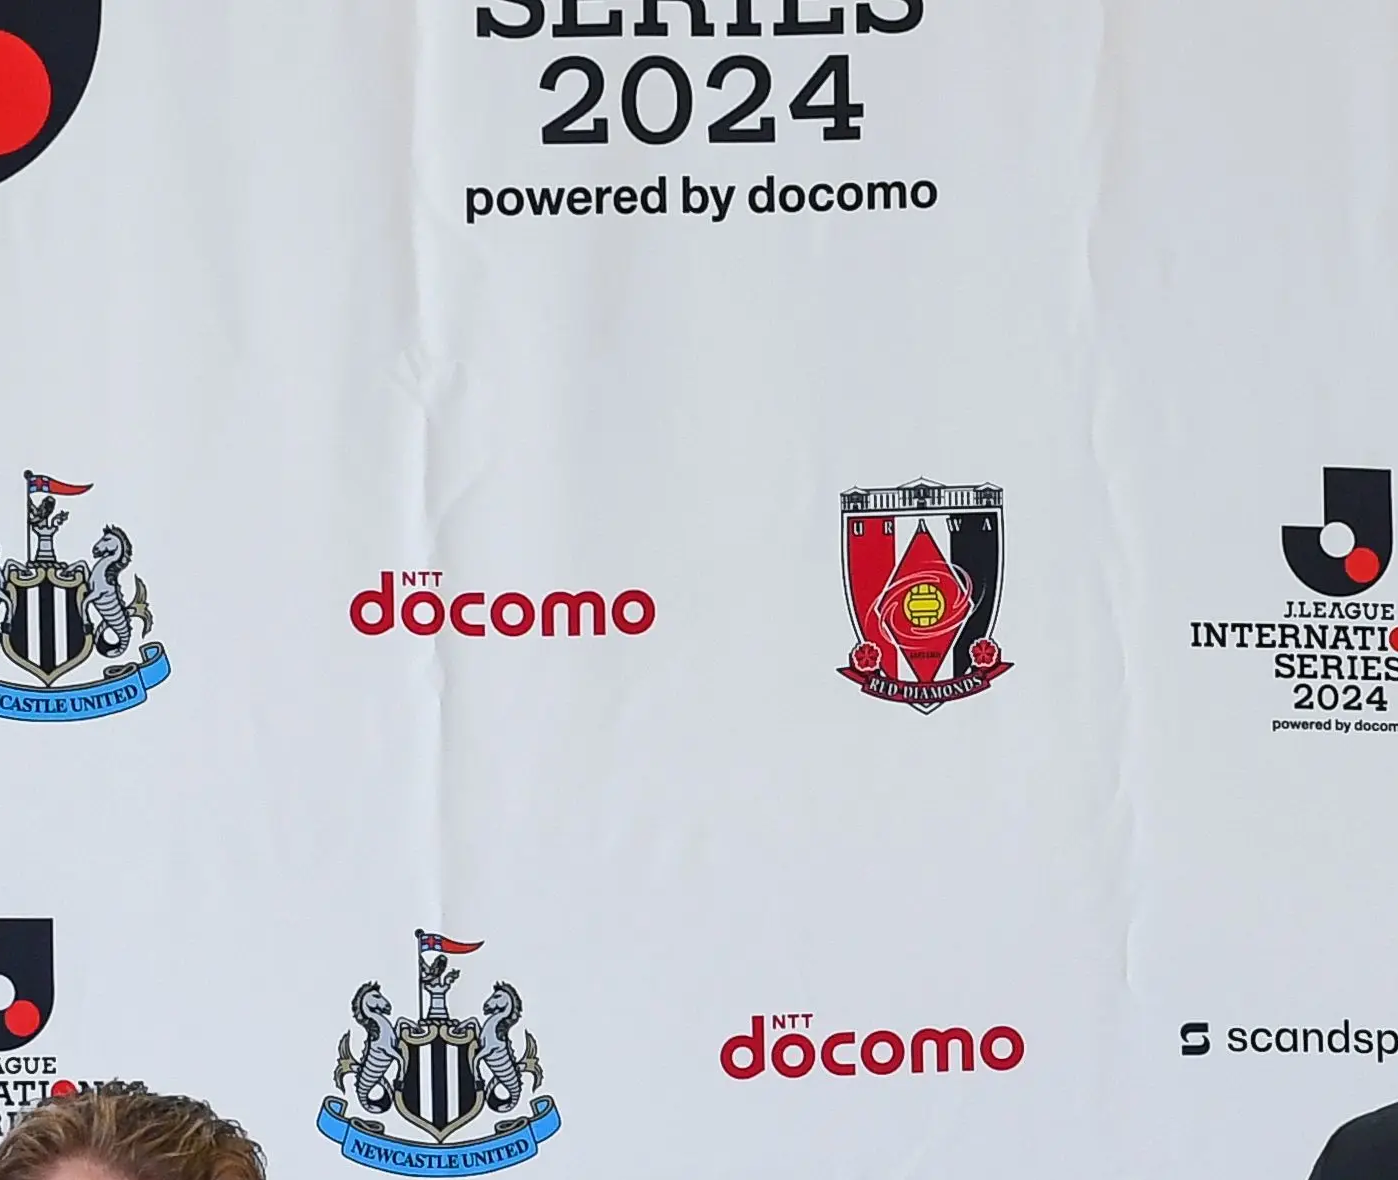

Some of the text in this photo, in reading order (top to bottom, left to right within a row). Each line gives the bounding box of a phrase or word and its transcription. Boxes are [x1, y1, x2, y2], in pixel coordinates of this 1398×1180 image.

[539, 54, 864, 145] 2024
[465, 175, 938, 224] powered by docomo
[402, 571, 444, 587] NTT
[349, 571, 657, 637] docomo
[1283, 601, 1395, 622] J.LEAGUE
[69, 682, 138, 713] UNITED
[867, 677, 982, 701] RED DIAMONDS
[1292, 684, 1388, 711] 2024
[1272, 717, 1332, 735] powered
[1334, 718, 1351, 735] by
[772, 1014, 813, 1029] NTT
[719, 1015, 1025, 1080] docomo
[351, 1137, 530, 1170] NEWCASTLE UNITED
